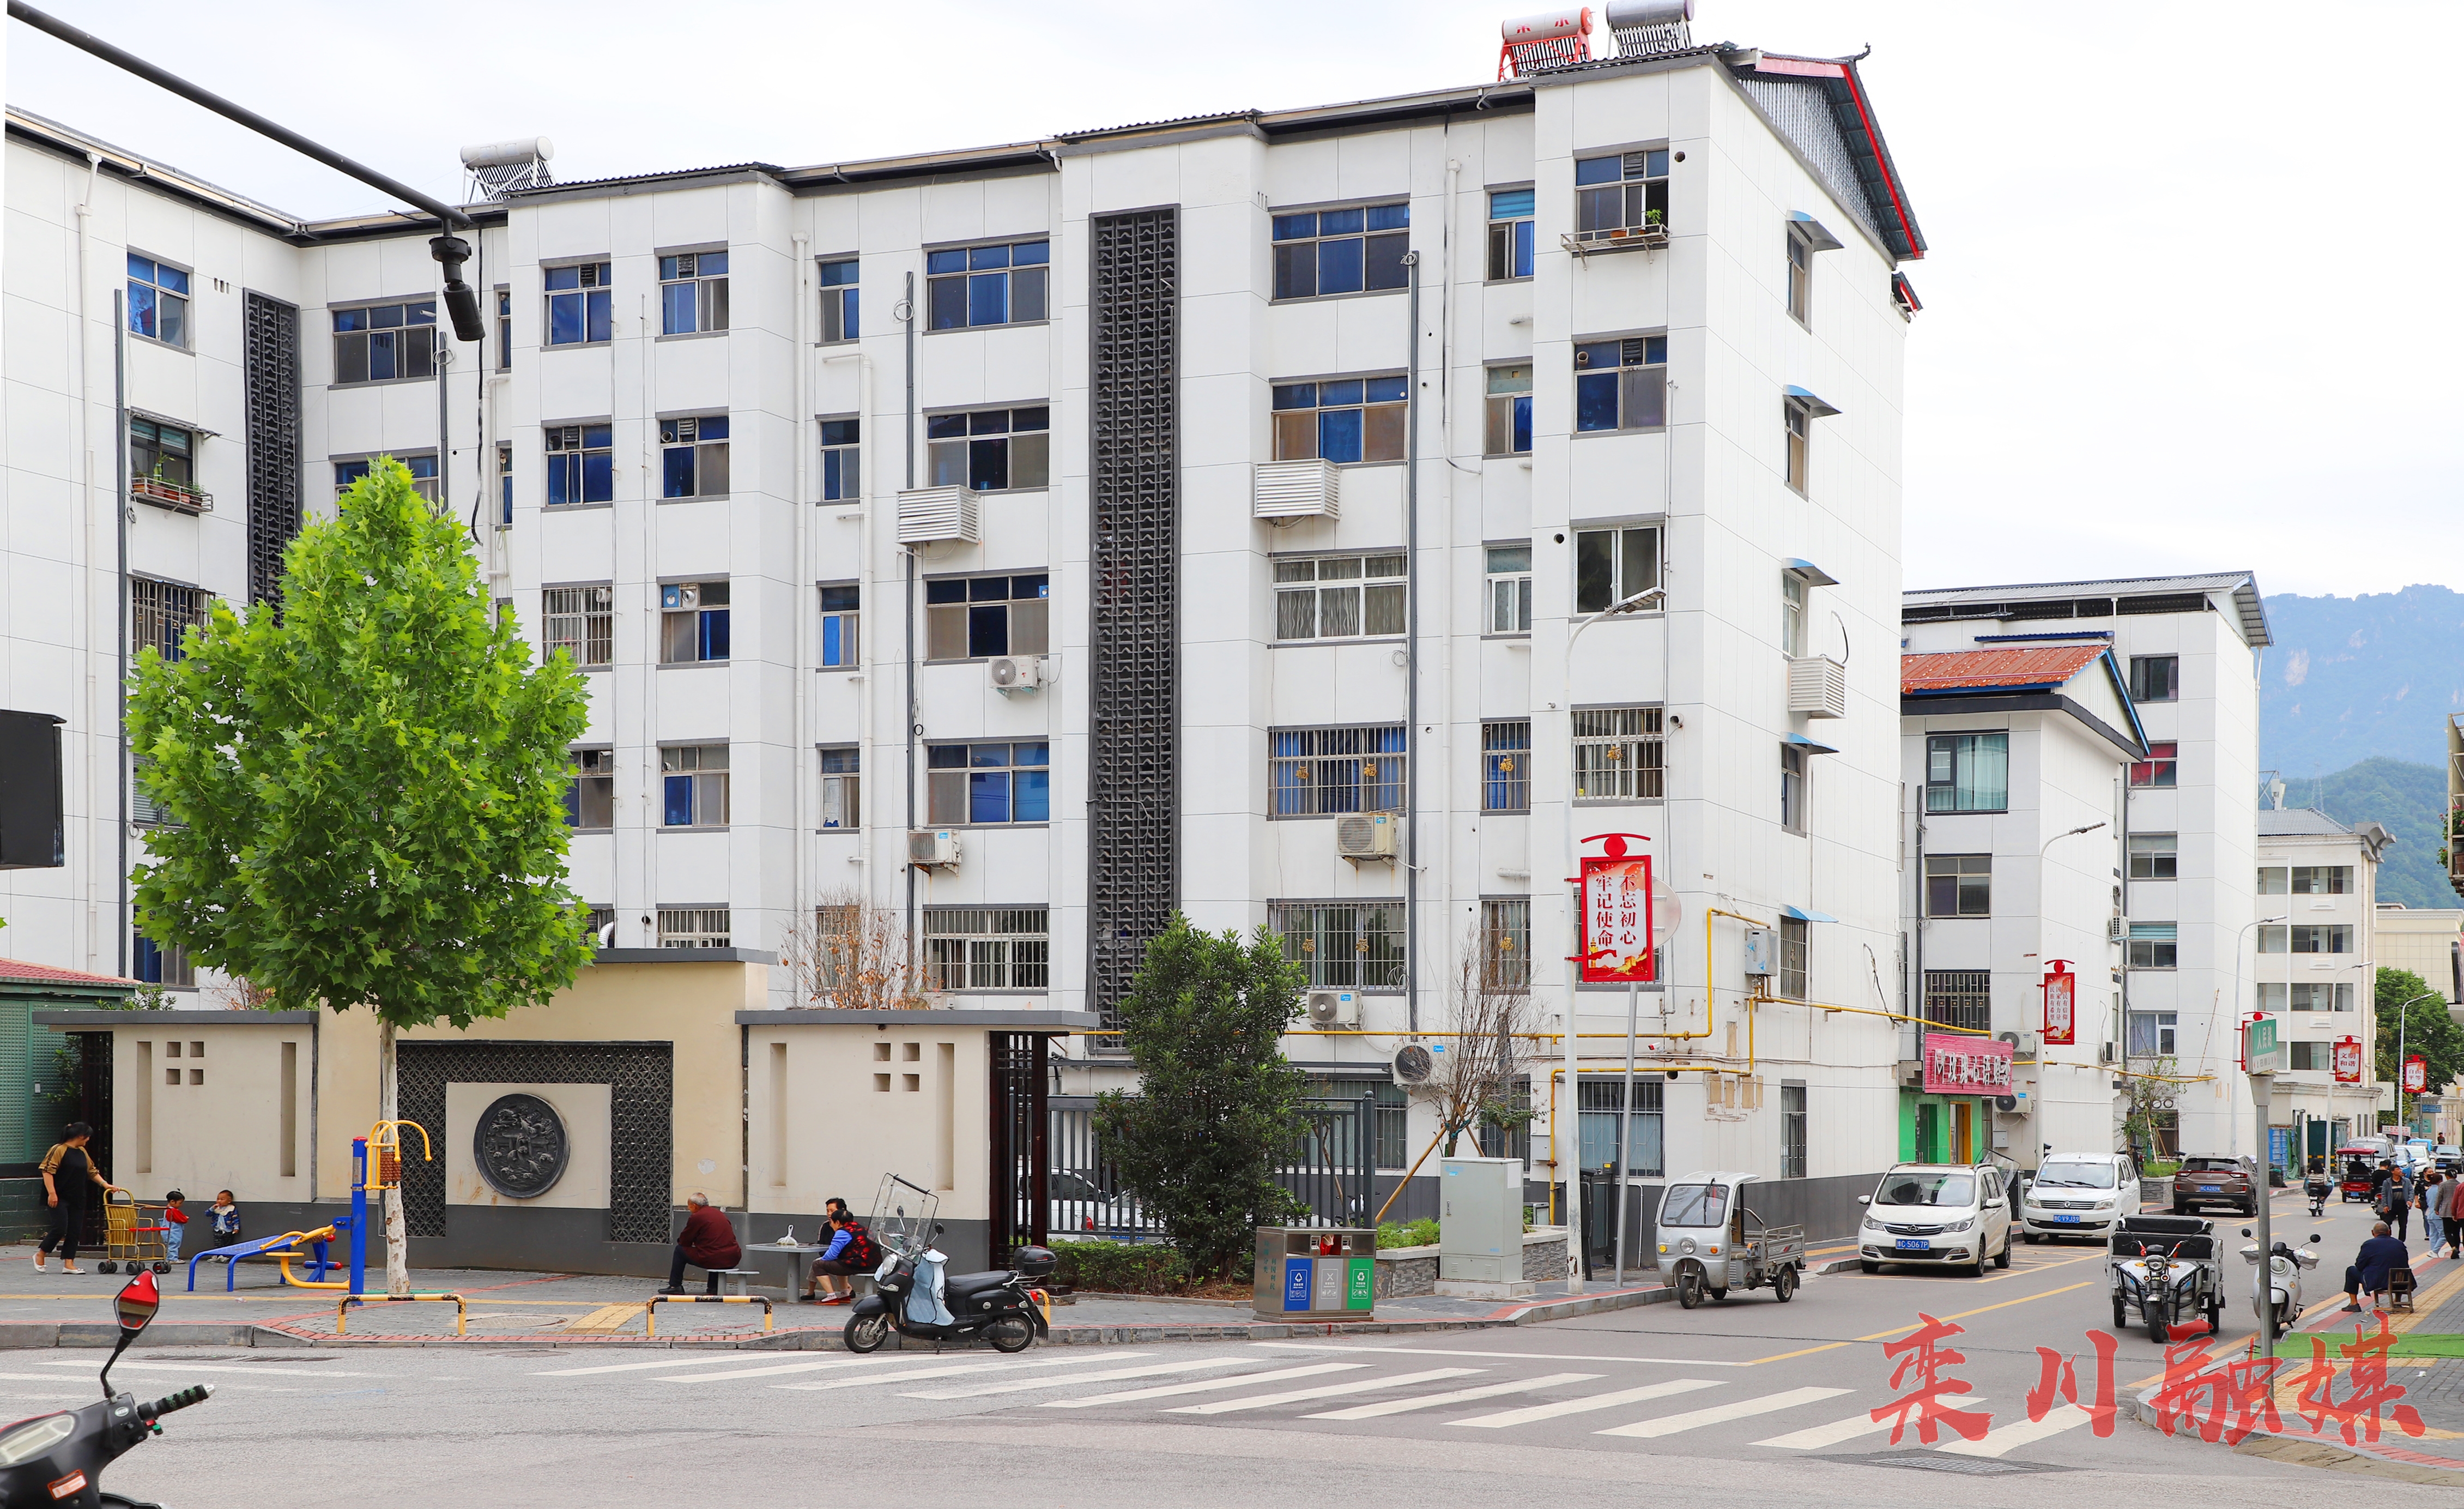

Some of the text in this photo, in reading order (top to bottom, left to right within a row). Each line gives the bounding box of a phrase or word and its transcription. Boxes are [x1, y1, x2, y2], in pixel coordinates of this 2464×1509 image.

[1607, 745, 1623, 760] 福
[1295, 765, 1309, 780] 福
[1364, 763, 1378, 777] 福
[1500, 758, 1514, 772] 福
[1595, 874, 1614, 947] 牢记使命
[1619, 874, 1637, 946] 不忘初心
[1302, 938, 1315, 952] 福
[1355, 938, 1369, 952] 福
[2257, 1025, 2272, 1051] 人民路
